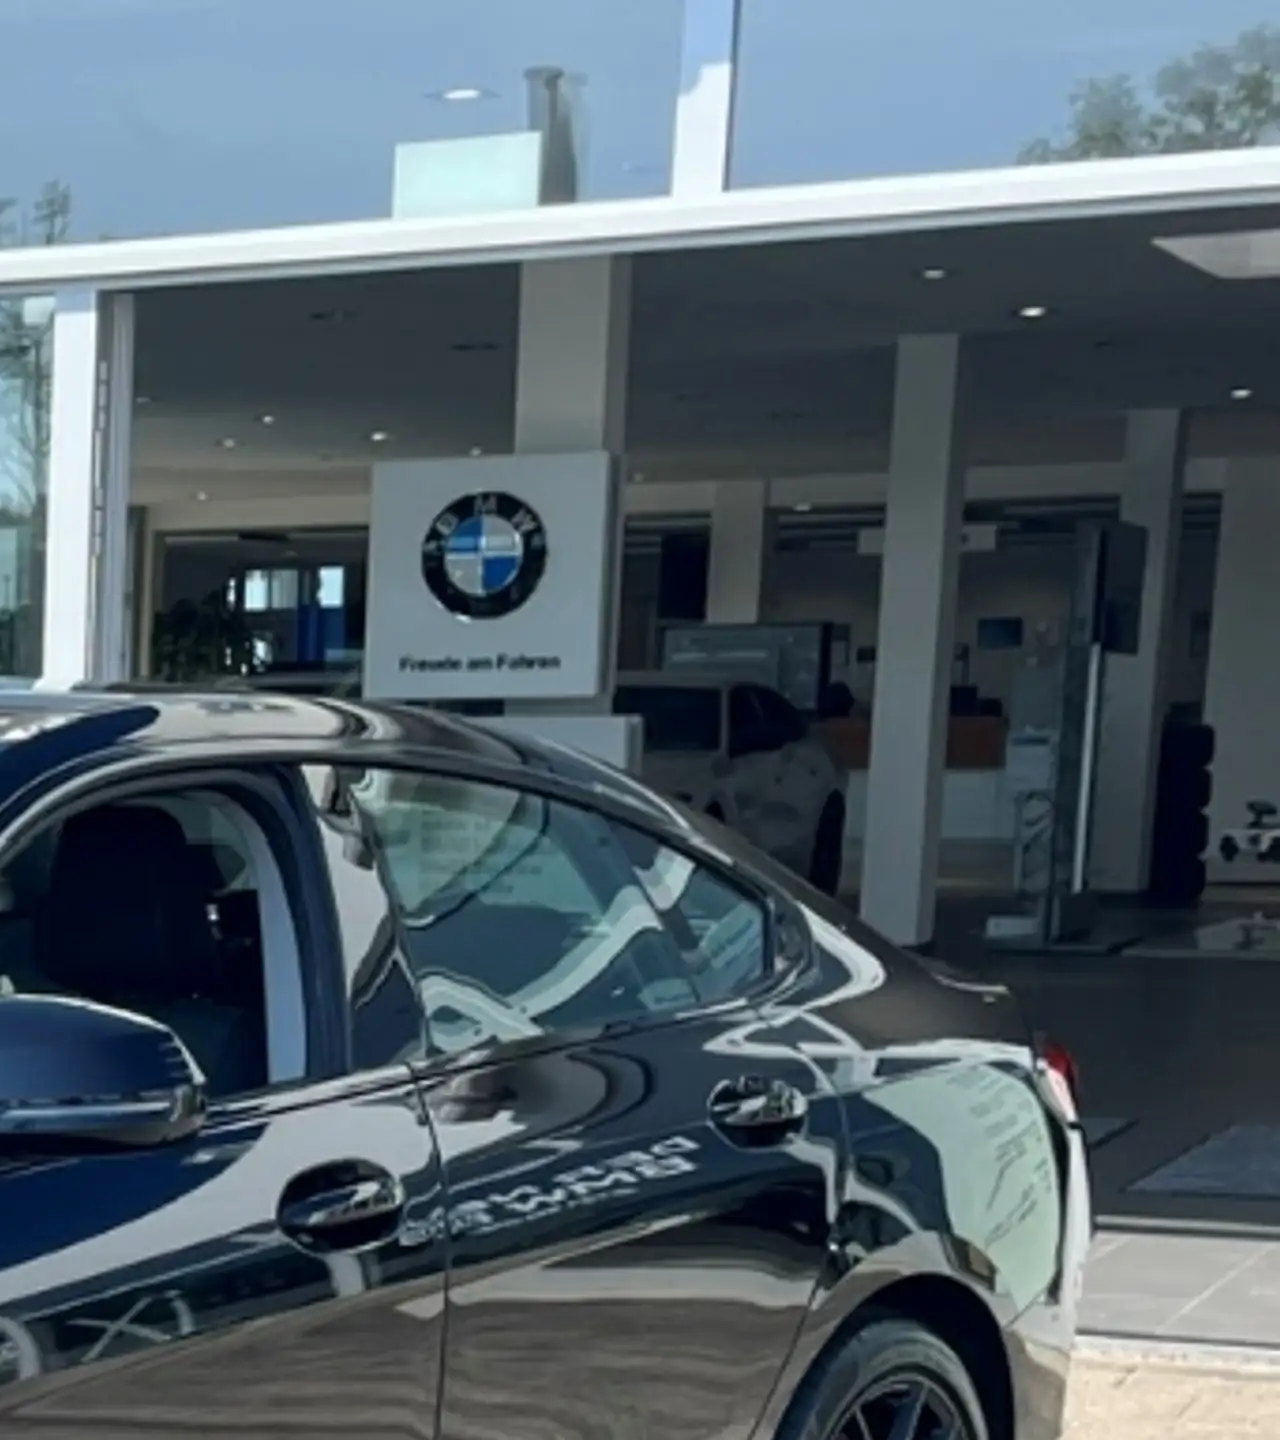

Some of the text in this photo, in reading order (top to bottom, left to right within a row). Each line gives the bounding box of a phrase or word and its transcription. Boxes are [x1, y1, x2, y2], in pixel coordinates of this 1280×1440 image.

[398, 654, 561, 671] Freude am Fahren
